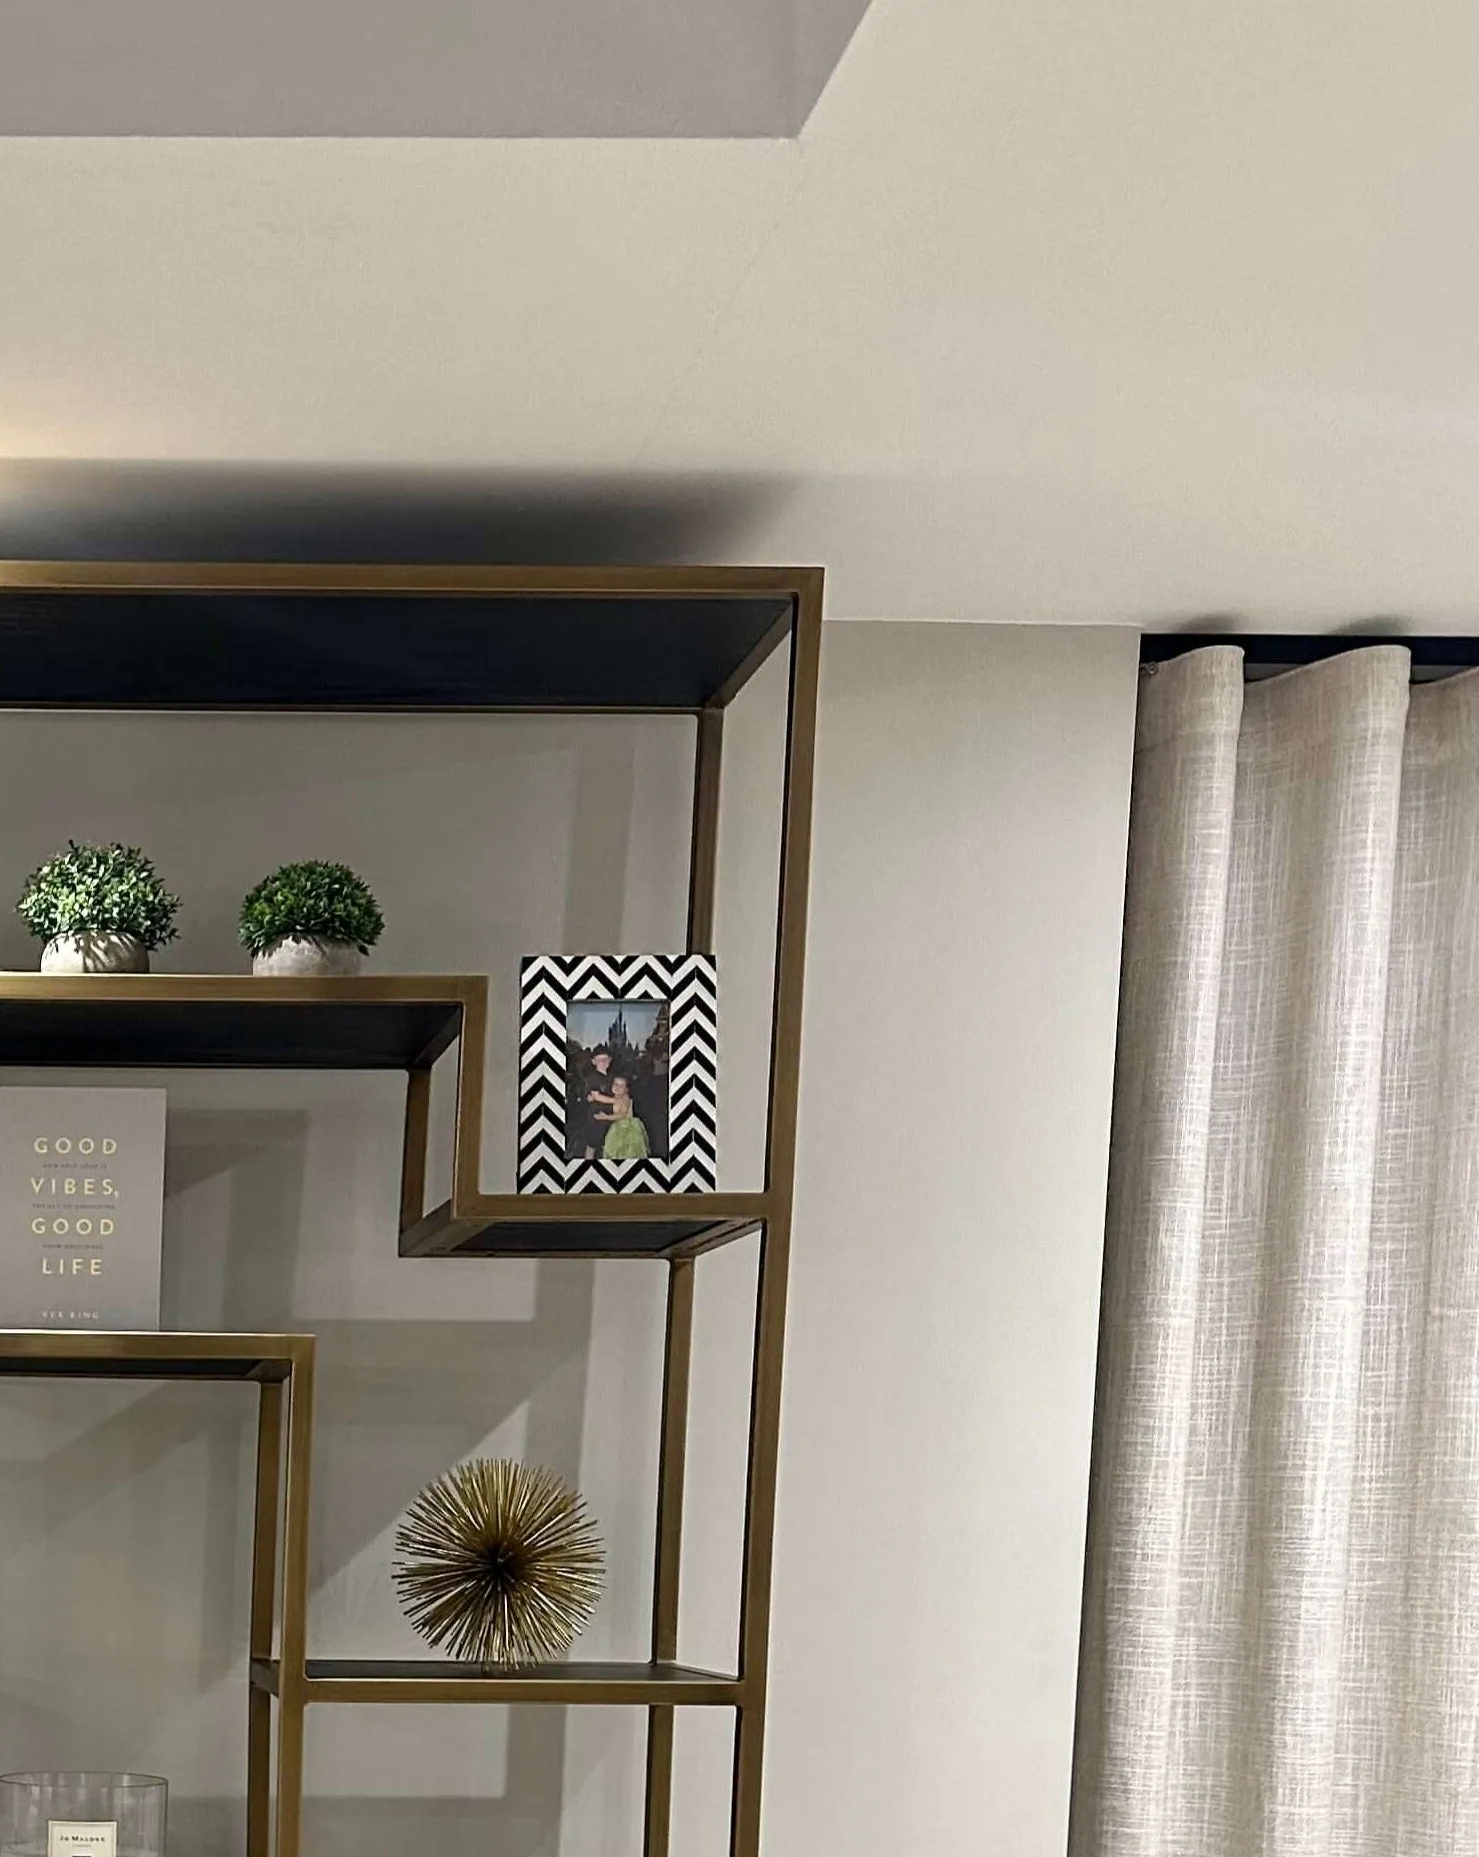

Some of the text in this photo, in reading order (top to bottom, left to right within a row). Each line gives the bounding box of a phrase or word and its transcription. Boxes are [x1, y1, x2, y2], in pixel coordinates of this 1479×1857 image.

[34, 1137, 117, 1154] GOOD
[30, 1177, 119, 1199] VIBES,
[31, 1217, 115, 1235] GOOD
[41, 1257, 103, 1275] LIFE
